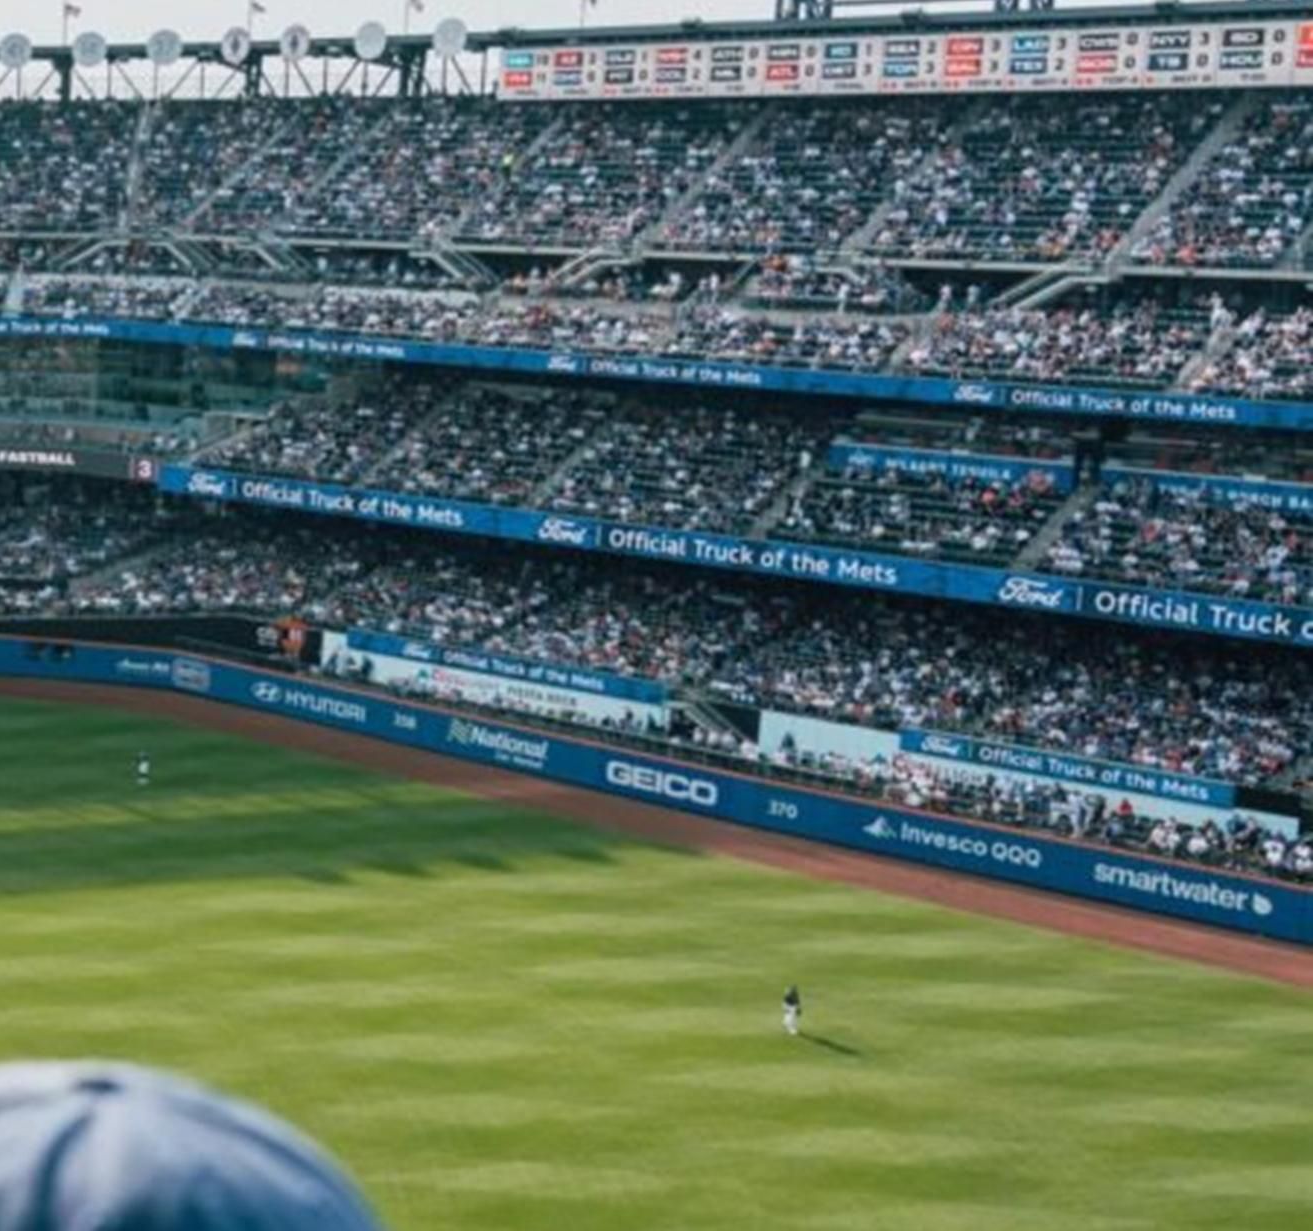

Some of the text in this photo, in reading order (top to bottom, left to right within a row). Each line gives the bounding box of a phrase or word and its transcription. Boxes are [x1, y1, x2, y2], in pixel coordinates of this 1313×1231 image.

[590, 357, 639, 375] Official
[642, 363, 677, 378] Truck
[726, 370, 762, 385] Mets
[953, 383, 1236, 419] Ford Official Truck of the Mets
[0, 451, 76, 466] FASTBALL
[138, 460, 152, 478] 3
[187, 472, 464, 528] Ford Official Truck of the Mets
[537, 519, 897, 587] Ford Official Truck of the Mets
[997, 576, 1066, 606] Ford
[1094, 591, 1198, 625] Official
[1207, 604, 1292, 638] Truck
[442, 650, 489, 668] Official
[492, 657, 525, 676] Truck
[284, 689, 367, 723] HYUNDAI
[469, 723, 549, 761] National
[605, 760, 718, 806] GEICO
[977, 745, 1043, 770] Official
[1047, 758, 1096, 780] Truck
[1100, 765, 1121, 786] of
[1124, 769, 1156, 791] the
[1160, 777, 1210, 801] Mets
[767, 800, 798, 819] 370
[899, 821, 1043, 868] Invesco QQQ
[1093, 862, 1250, 911] smartwater
